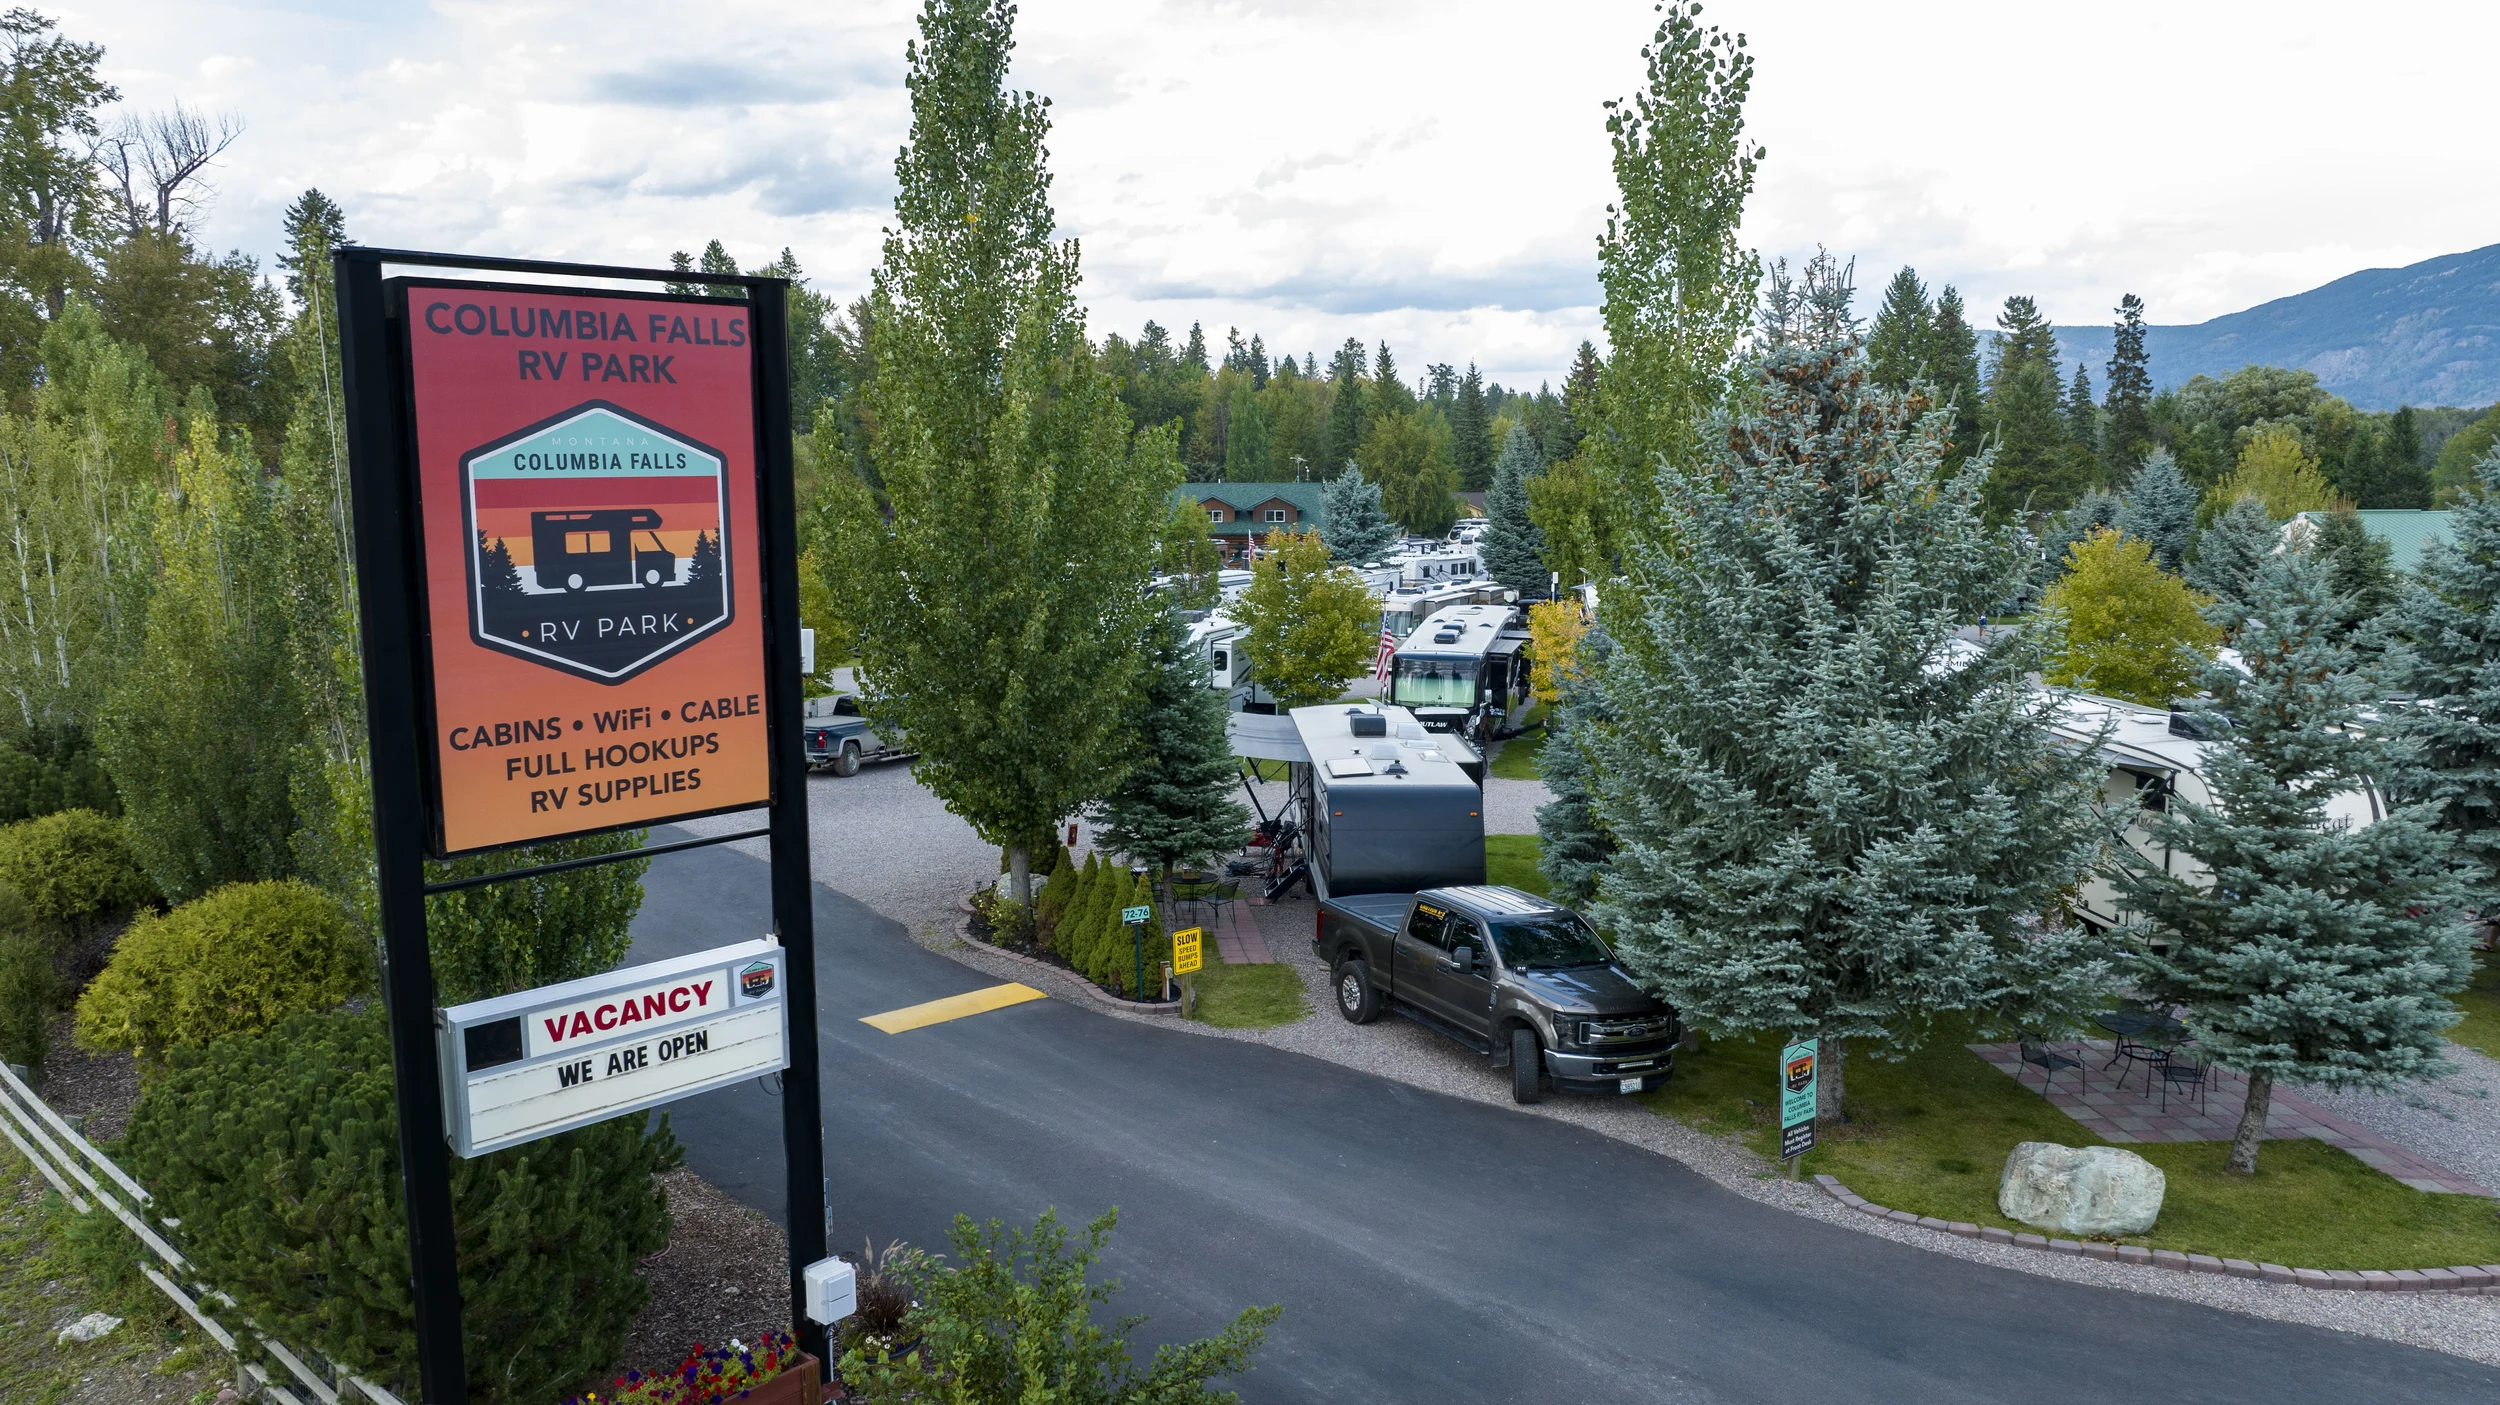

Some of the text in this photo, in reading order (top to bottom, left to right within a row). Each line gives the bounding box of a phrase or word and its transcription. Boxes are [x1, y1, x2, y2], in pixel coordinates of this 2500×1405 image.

[424, 302, 746, 348] COLUMBIA FALLS
[518, 350, 678, 384] RV PARK
[552, 437, 649, 446] MONTANA
[513, 452, 687, 471] COLUMBIA FALLS
[540, 612, 680, 643] RV PARK
[449, 694, 760, 752] CABINS WiFi CABLE
[506, 732, 719, 781] FULL HOOKUPS
[530, 768, 701, 814] RV SUPPLIES
[1125, 908, 1148, 918] 72-76
[1177, 932, 1198, 946] SLOW
[1178, 945, 1197, 955] SPEED
[1178, 952, 1198, 962] BUMPS
[1178, 960, 1198, 970] AHEAD
[544, 980, 714, 1042] VACANCY
[558, 1030, 709, 1088] WE ARE OPEN
[1785, 1094, 1806, 1106] WELCOME
[1788, 1100, 1810, 1113] COLUMBIA
[1784, 1113, 1796, 1122] FALLS
[1803, 1107, 1814, 1115] PARK
